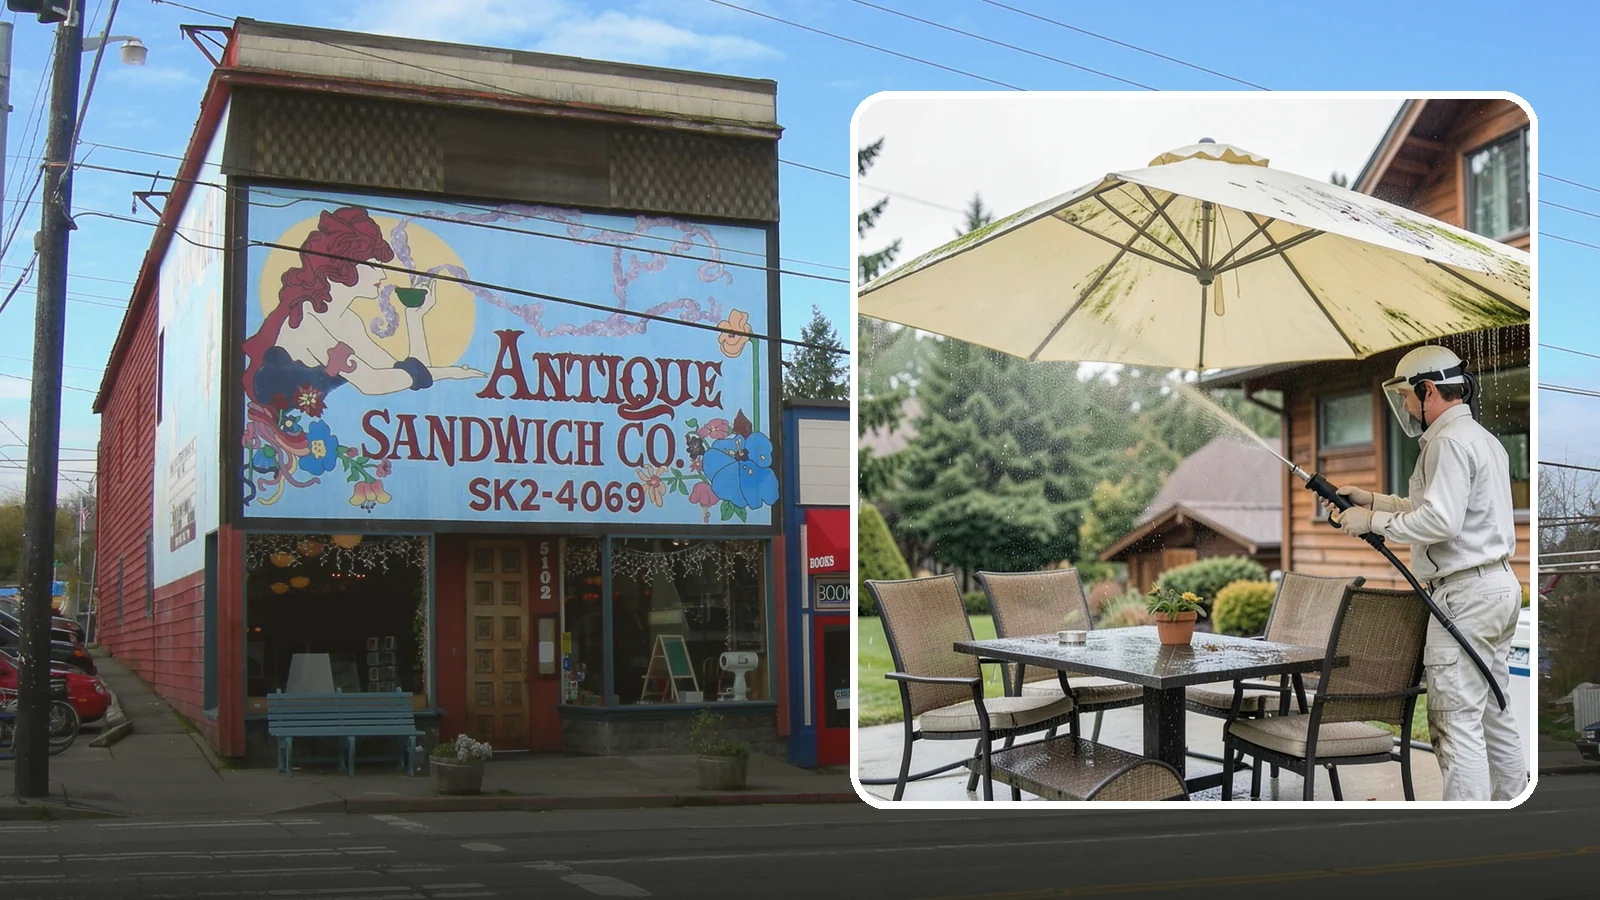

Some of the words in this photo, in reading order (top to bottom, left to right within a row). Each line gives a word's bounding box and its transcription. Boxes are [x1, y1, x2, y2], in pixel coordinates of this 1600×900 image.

[475, 329, 723, 420] ANTIQUE
[362, 408, 604, 467] SANDWICH
[617, 422, 685, 470] CO.
[468, 477, 646, 513] SK2-4069
[540, 541, 551, 600] 5102
[809, 555, 834, 569] BOOKS
